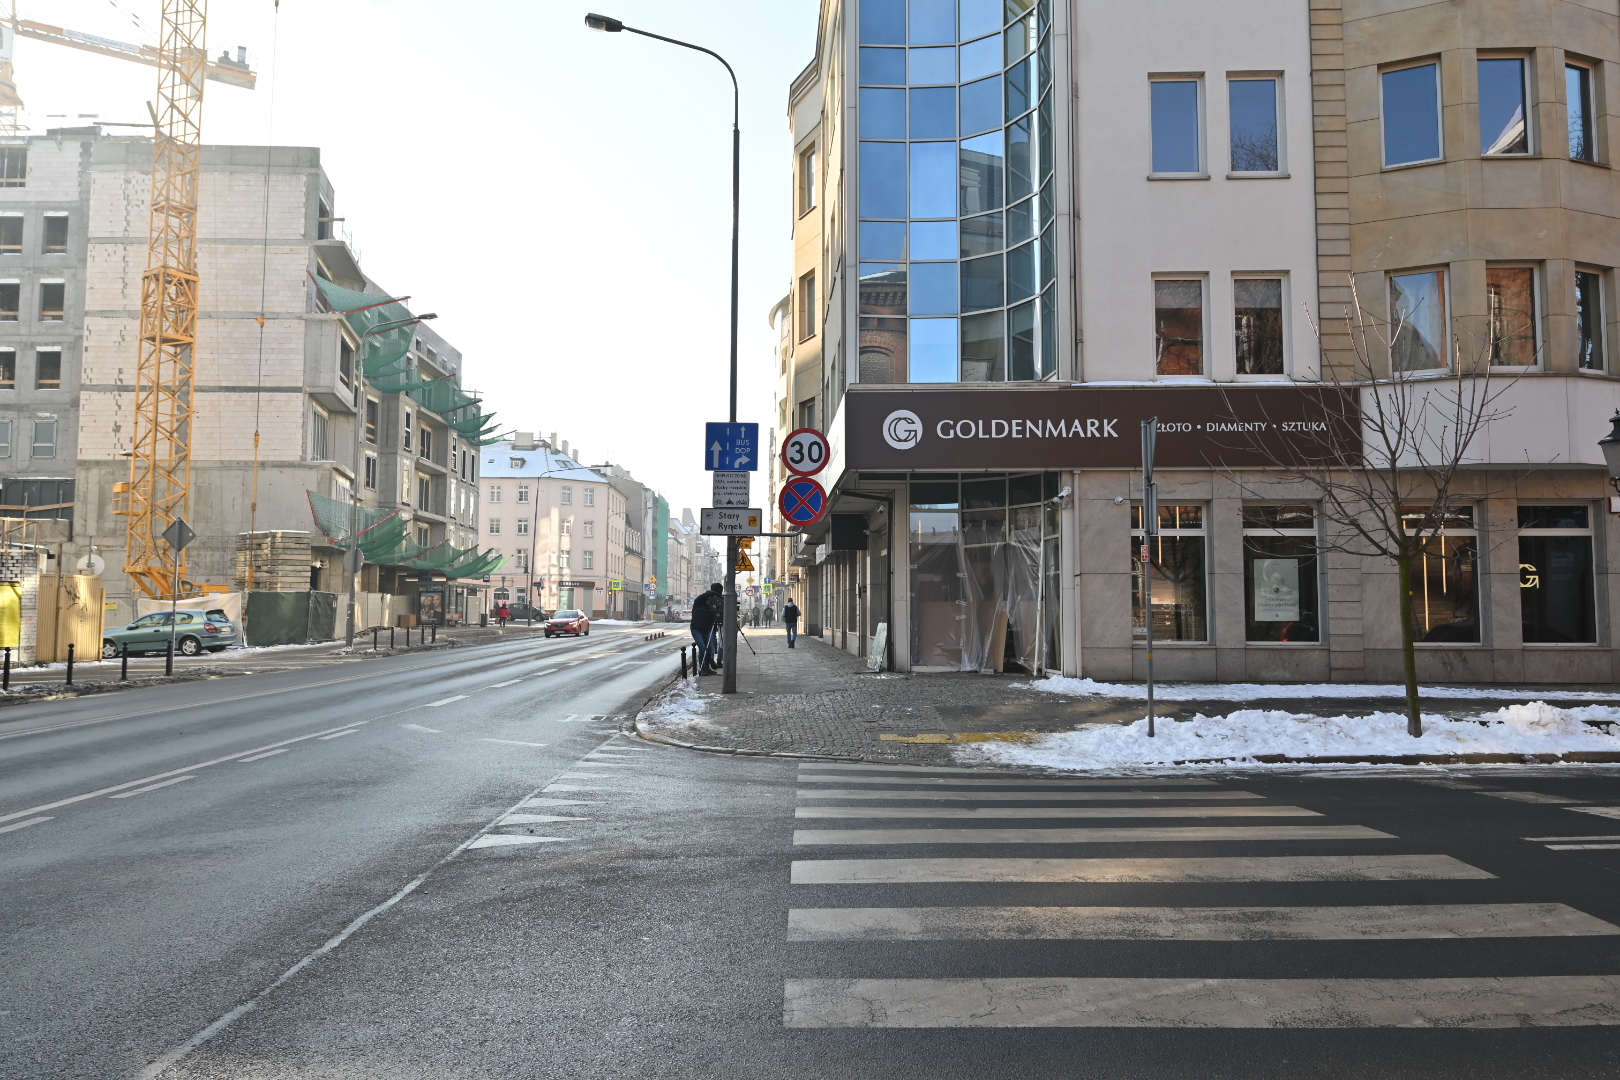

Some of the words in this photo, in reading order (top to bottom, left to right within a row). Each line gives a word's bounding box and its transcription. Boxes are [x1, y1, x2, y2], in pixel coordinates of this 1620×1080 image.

[936, 418, 1119, 440] GOLDENMARK
[1156, 422, 1192, 432] ZŁOTO
[1206, 422, 1267, 432] DIAMENTY
[1282, 422, 1327, 432] SZTUKA
[790, 440, 822, 464] 30
[718, 512, 740, 521] Stary
[718, 522, 743, 532] Rynek
